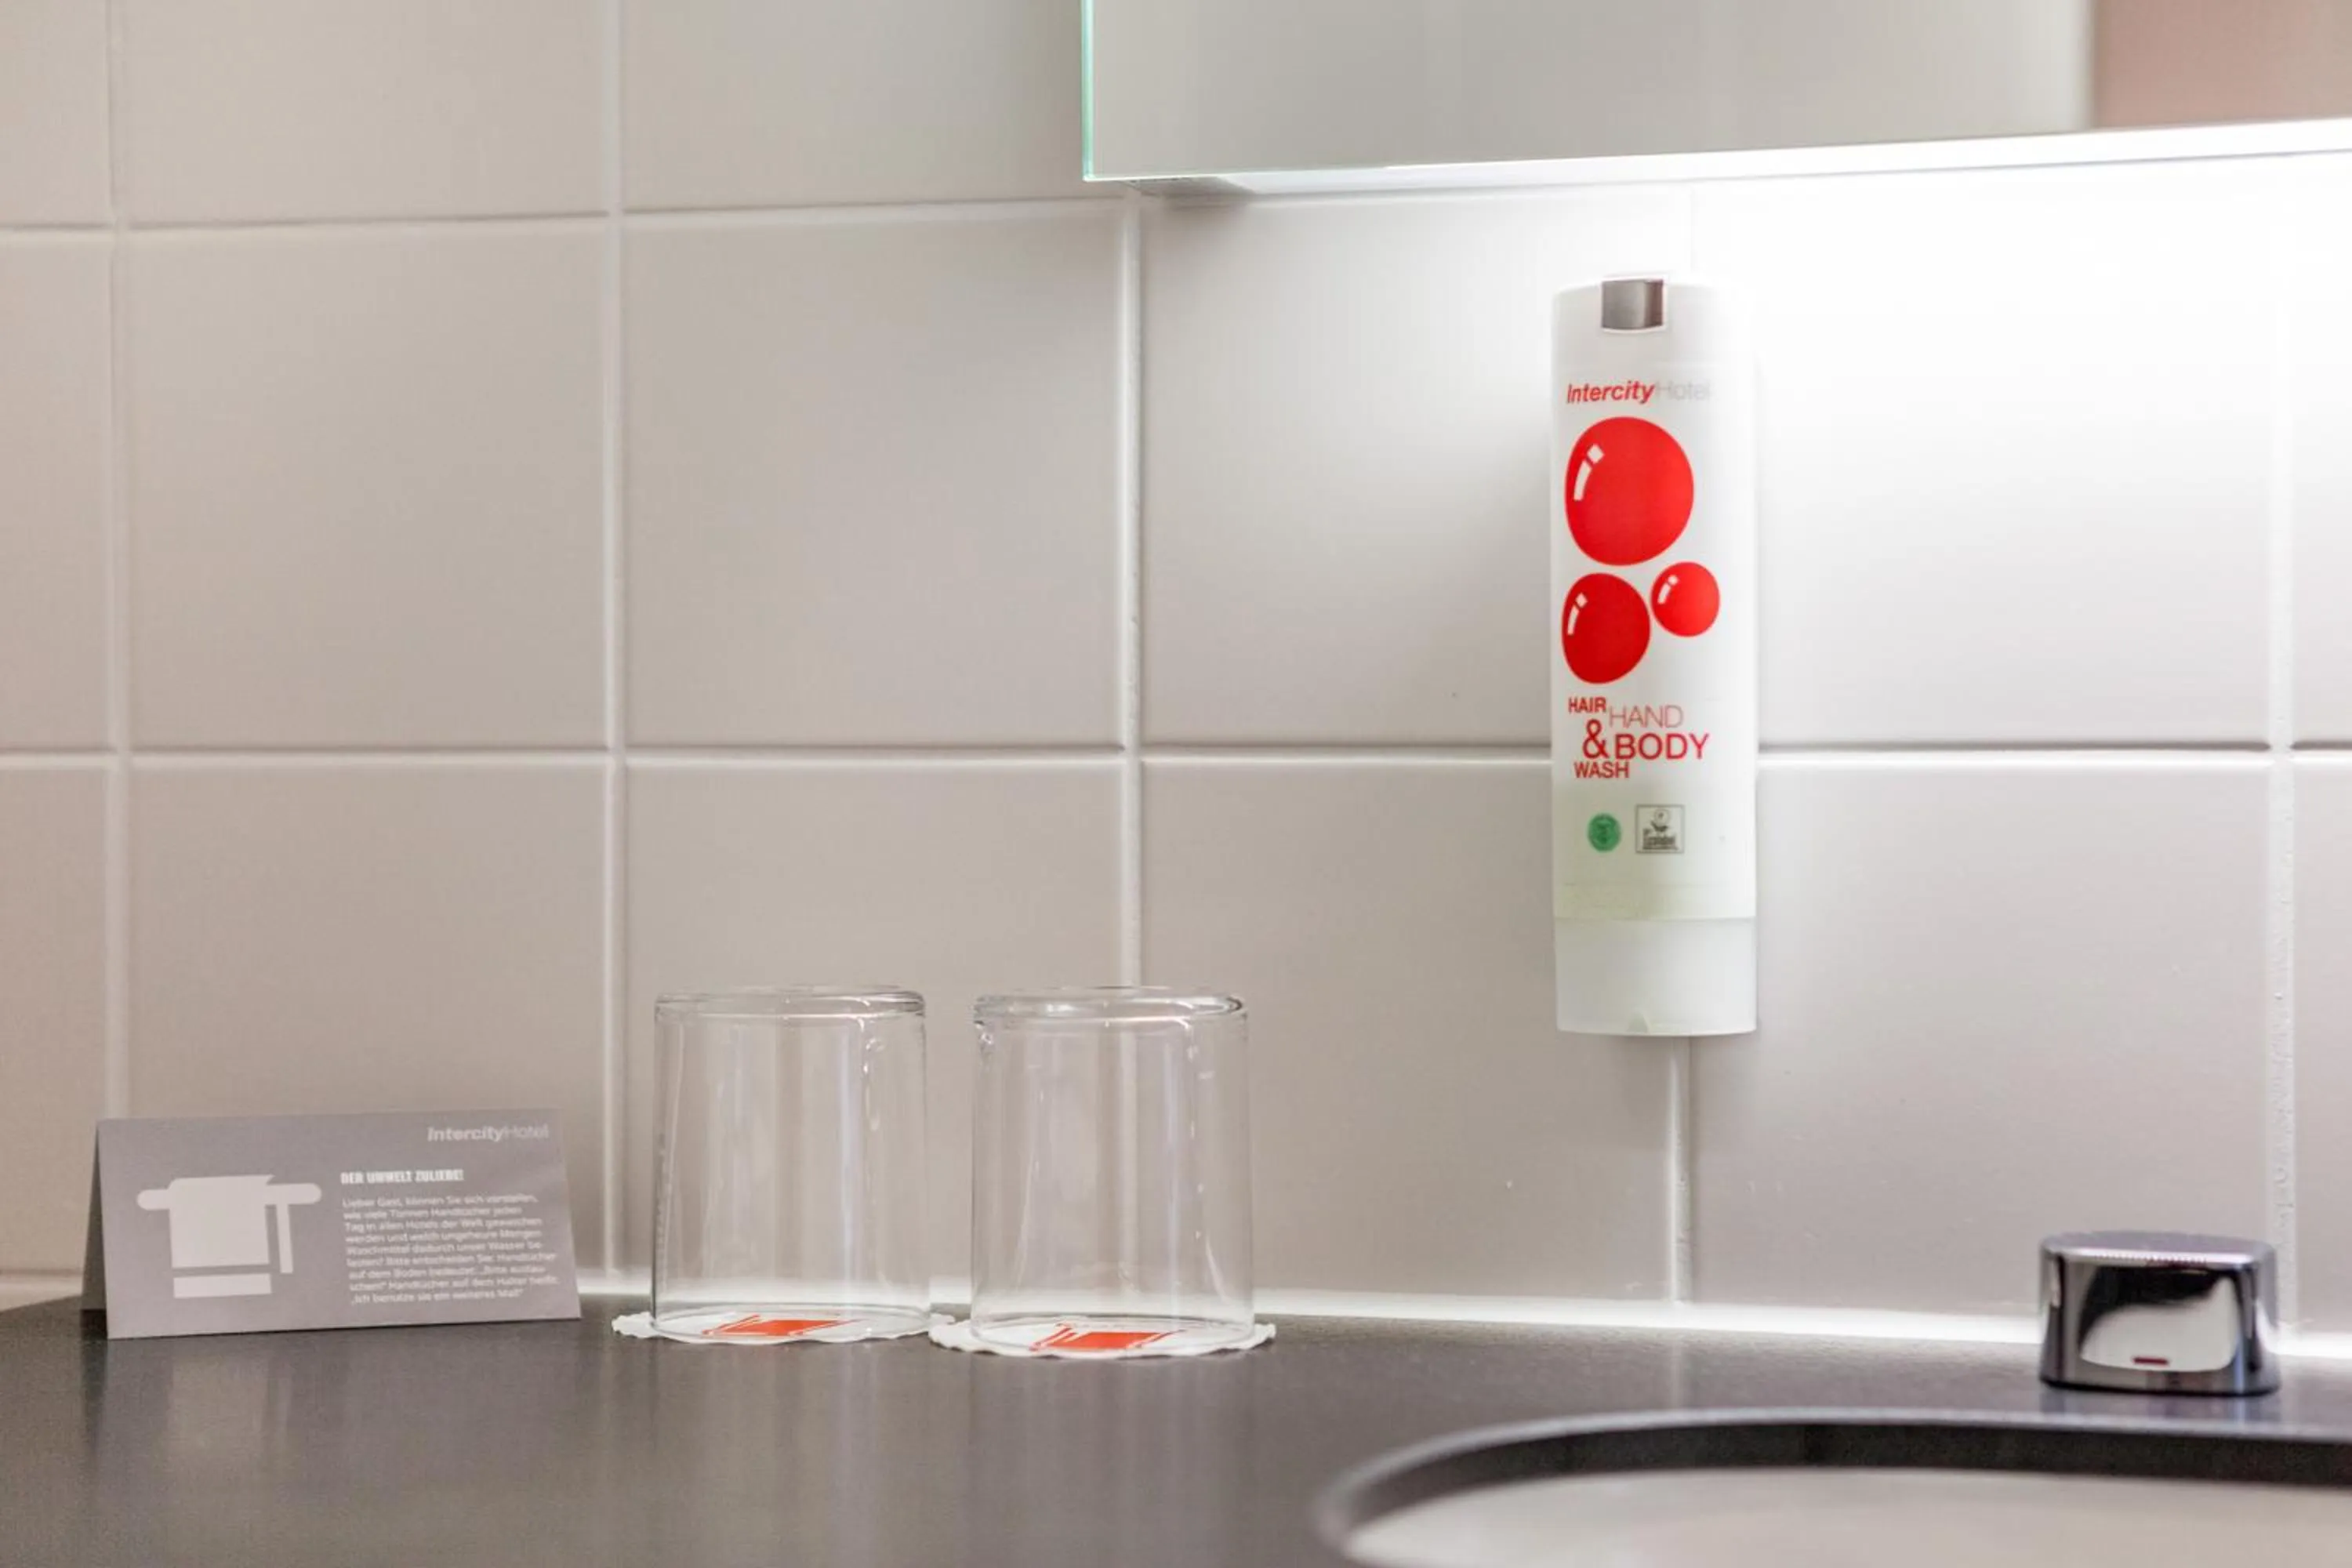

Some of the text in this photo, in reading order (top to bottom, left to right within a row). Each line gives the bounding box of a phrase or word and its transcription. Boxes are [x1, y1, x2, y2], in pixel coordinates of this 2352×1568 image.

[1568, 696, 1607, 713] HAIR
[1609, 705, 1685, 729] HAND
[1582, 718, 1710, 760] & BODY
[1573, 760, 1630, 779] WASH
[339, 1171, 365, 1185] DER
